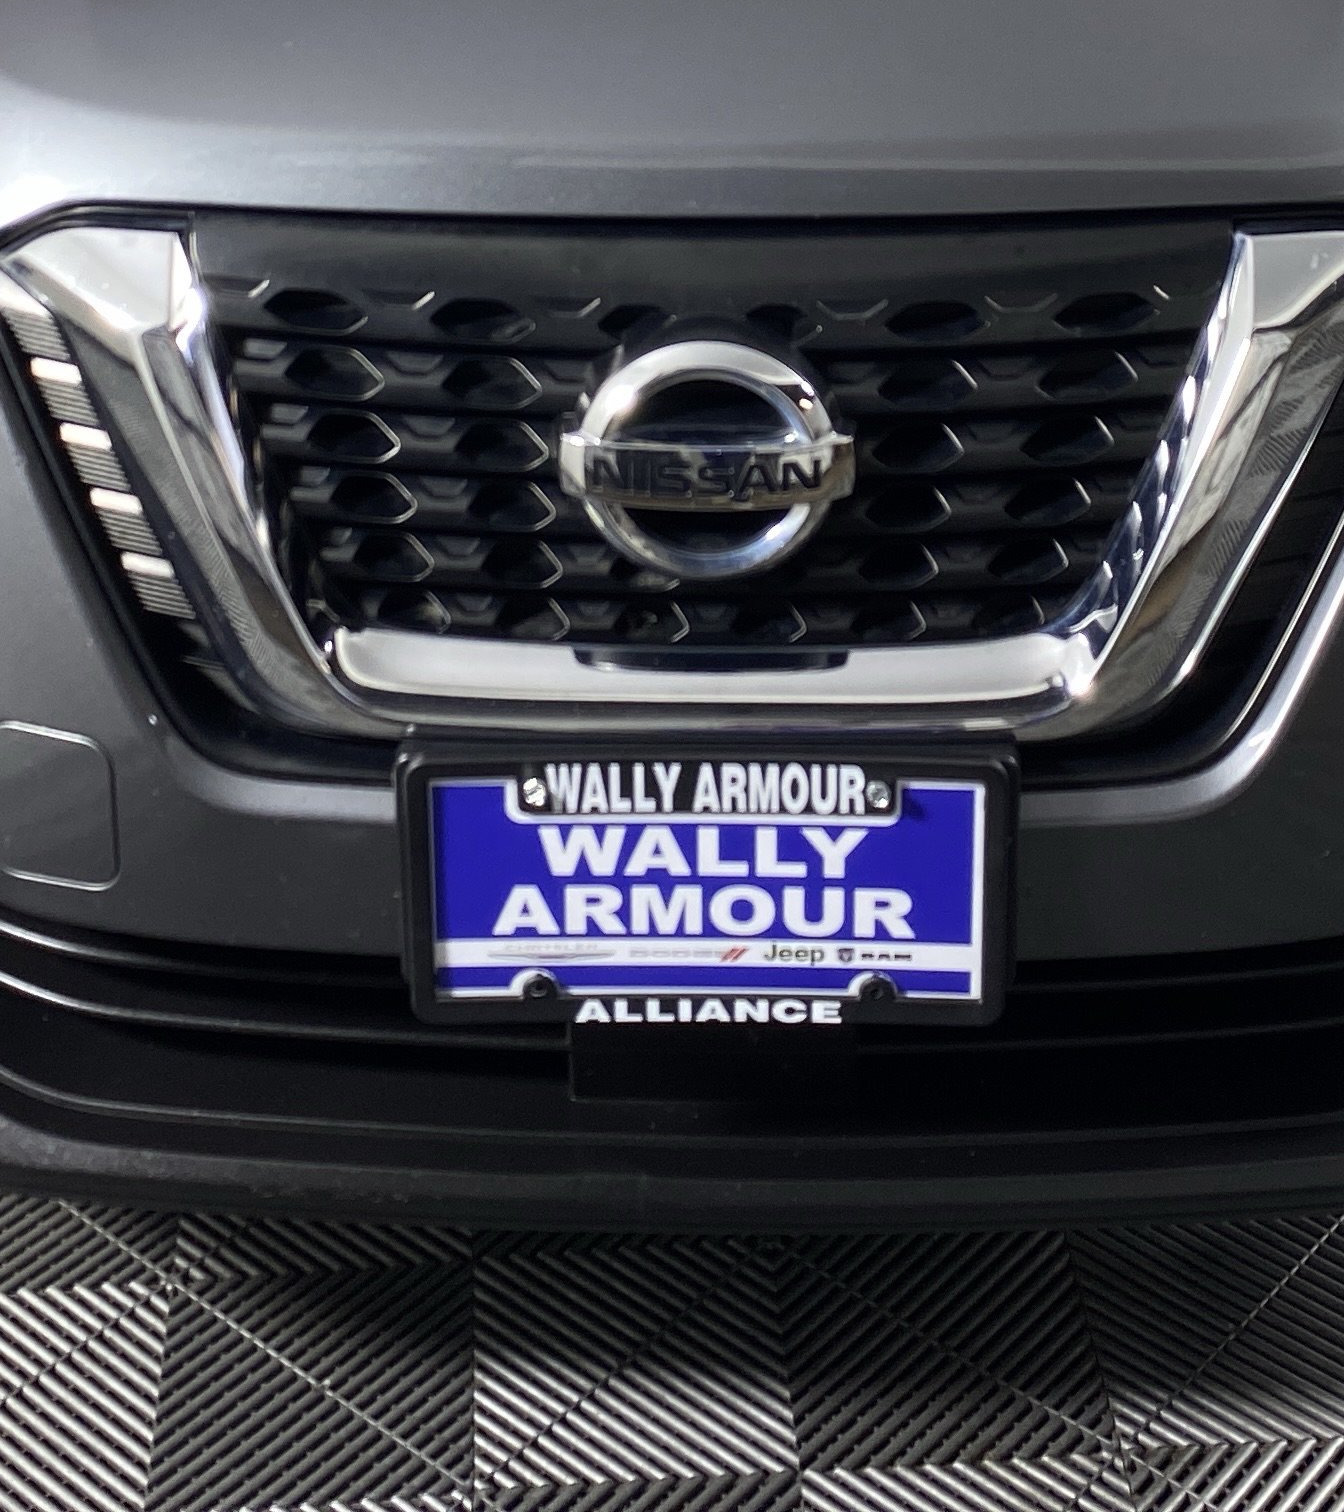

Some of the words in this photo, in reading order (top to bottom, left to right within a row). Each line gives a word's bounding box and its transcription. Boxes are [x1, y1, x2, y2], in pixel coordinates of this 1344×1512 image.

[589, 453, 825, 500] NISSAN
[544, 762, 682, 815] WALLY
[692, 762, 868, 815] ARMOUR
[537, 825, 870, 879] WALLY
[491, 884, 916, 940] ARMOUR
[763, 943, 825, 966] Jeep
[574, 998, 843, 1024] ALLIANCE
